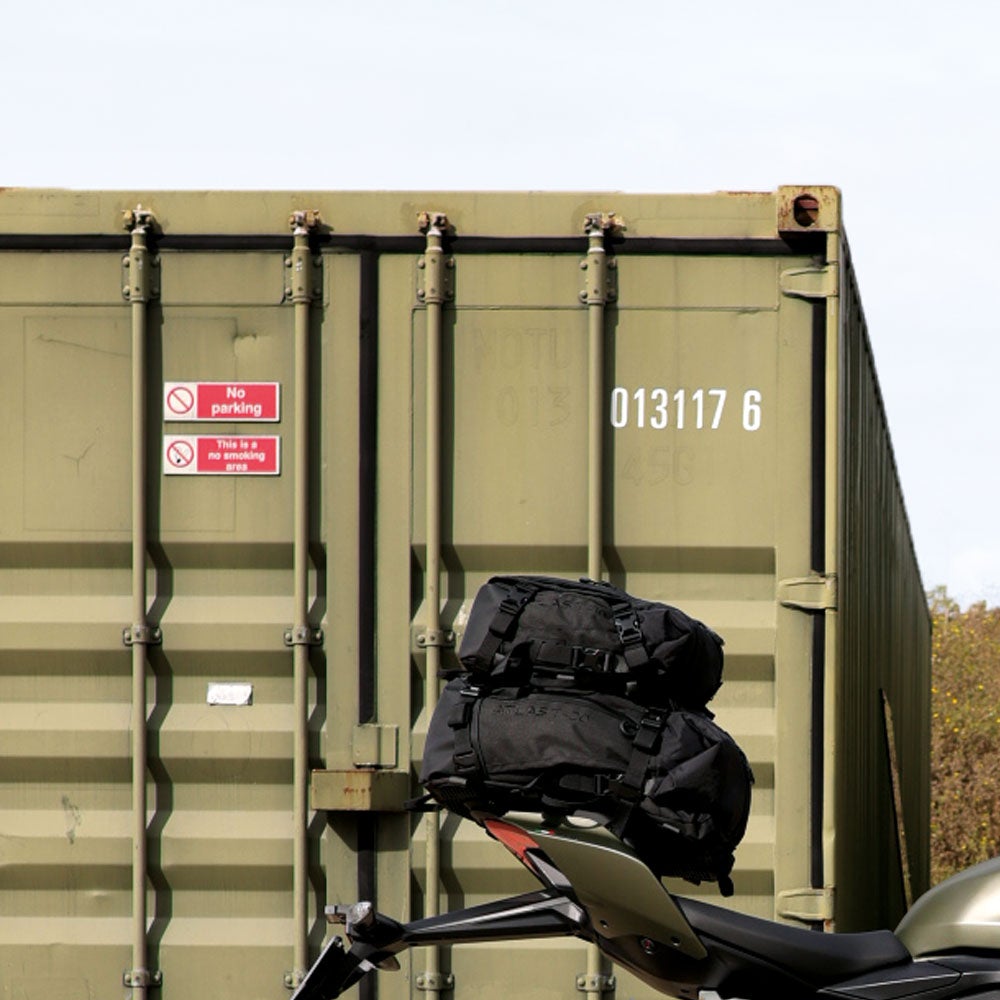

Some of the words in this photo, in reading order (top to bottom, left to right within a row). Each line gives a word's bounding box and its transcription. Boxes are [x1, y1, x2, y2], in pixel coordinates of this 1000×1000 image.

[226, 387, 245, 398] No
[211, 401, 262, 417] parking
[611, 387, 727, 429] 013117
[742, 389, 762, 431] 6
[216, 440, 237, 449] This
[240, 440, 249, 449] is
[251, 441, 258, 449] a
[208, 452, 221, 460] no
[223, 451, 266, 462] smoking
[226, 463, 248, 471] area
